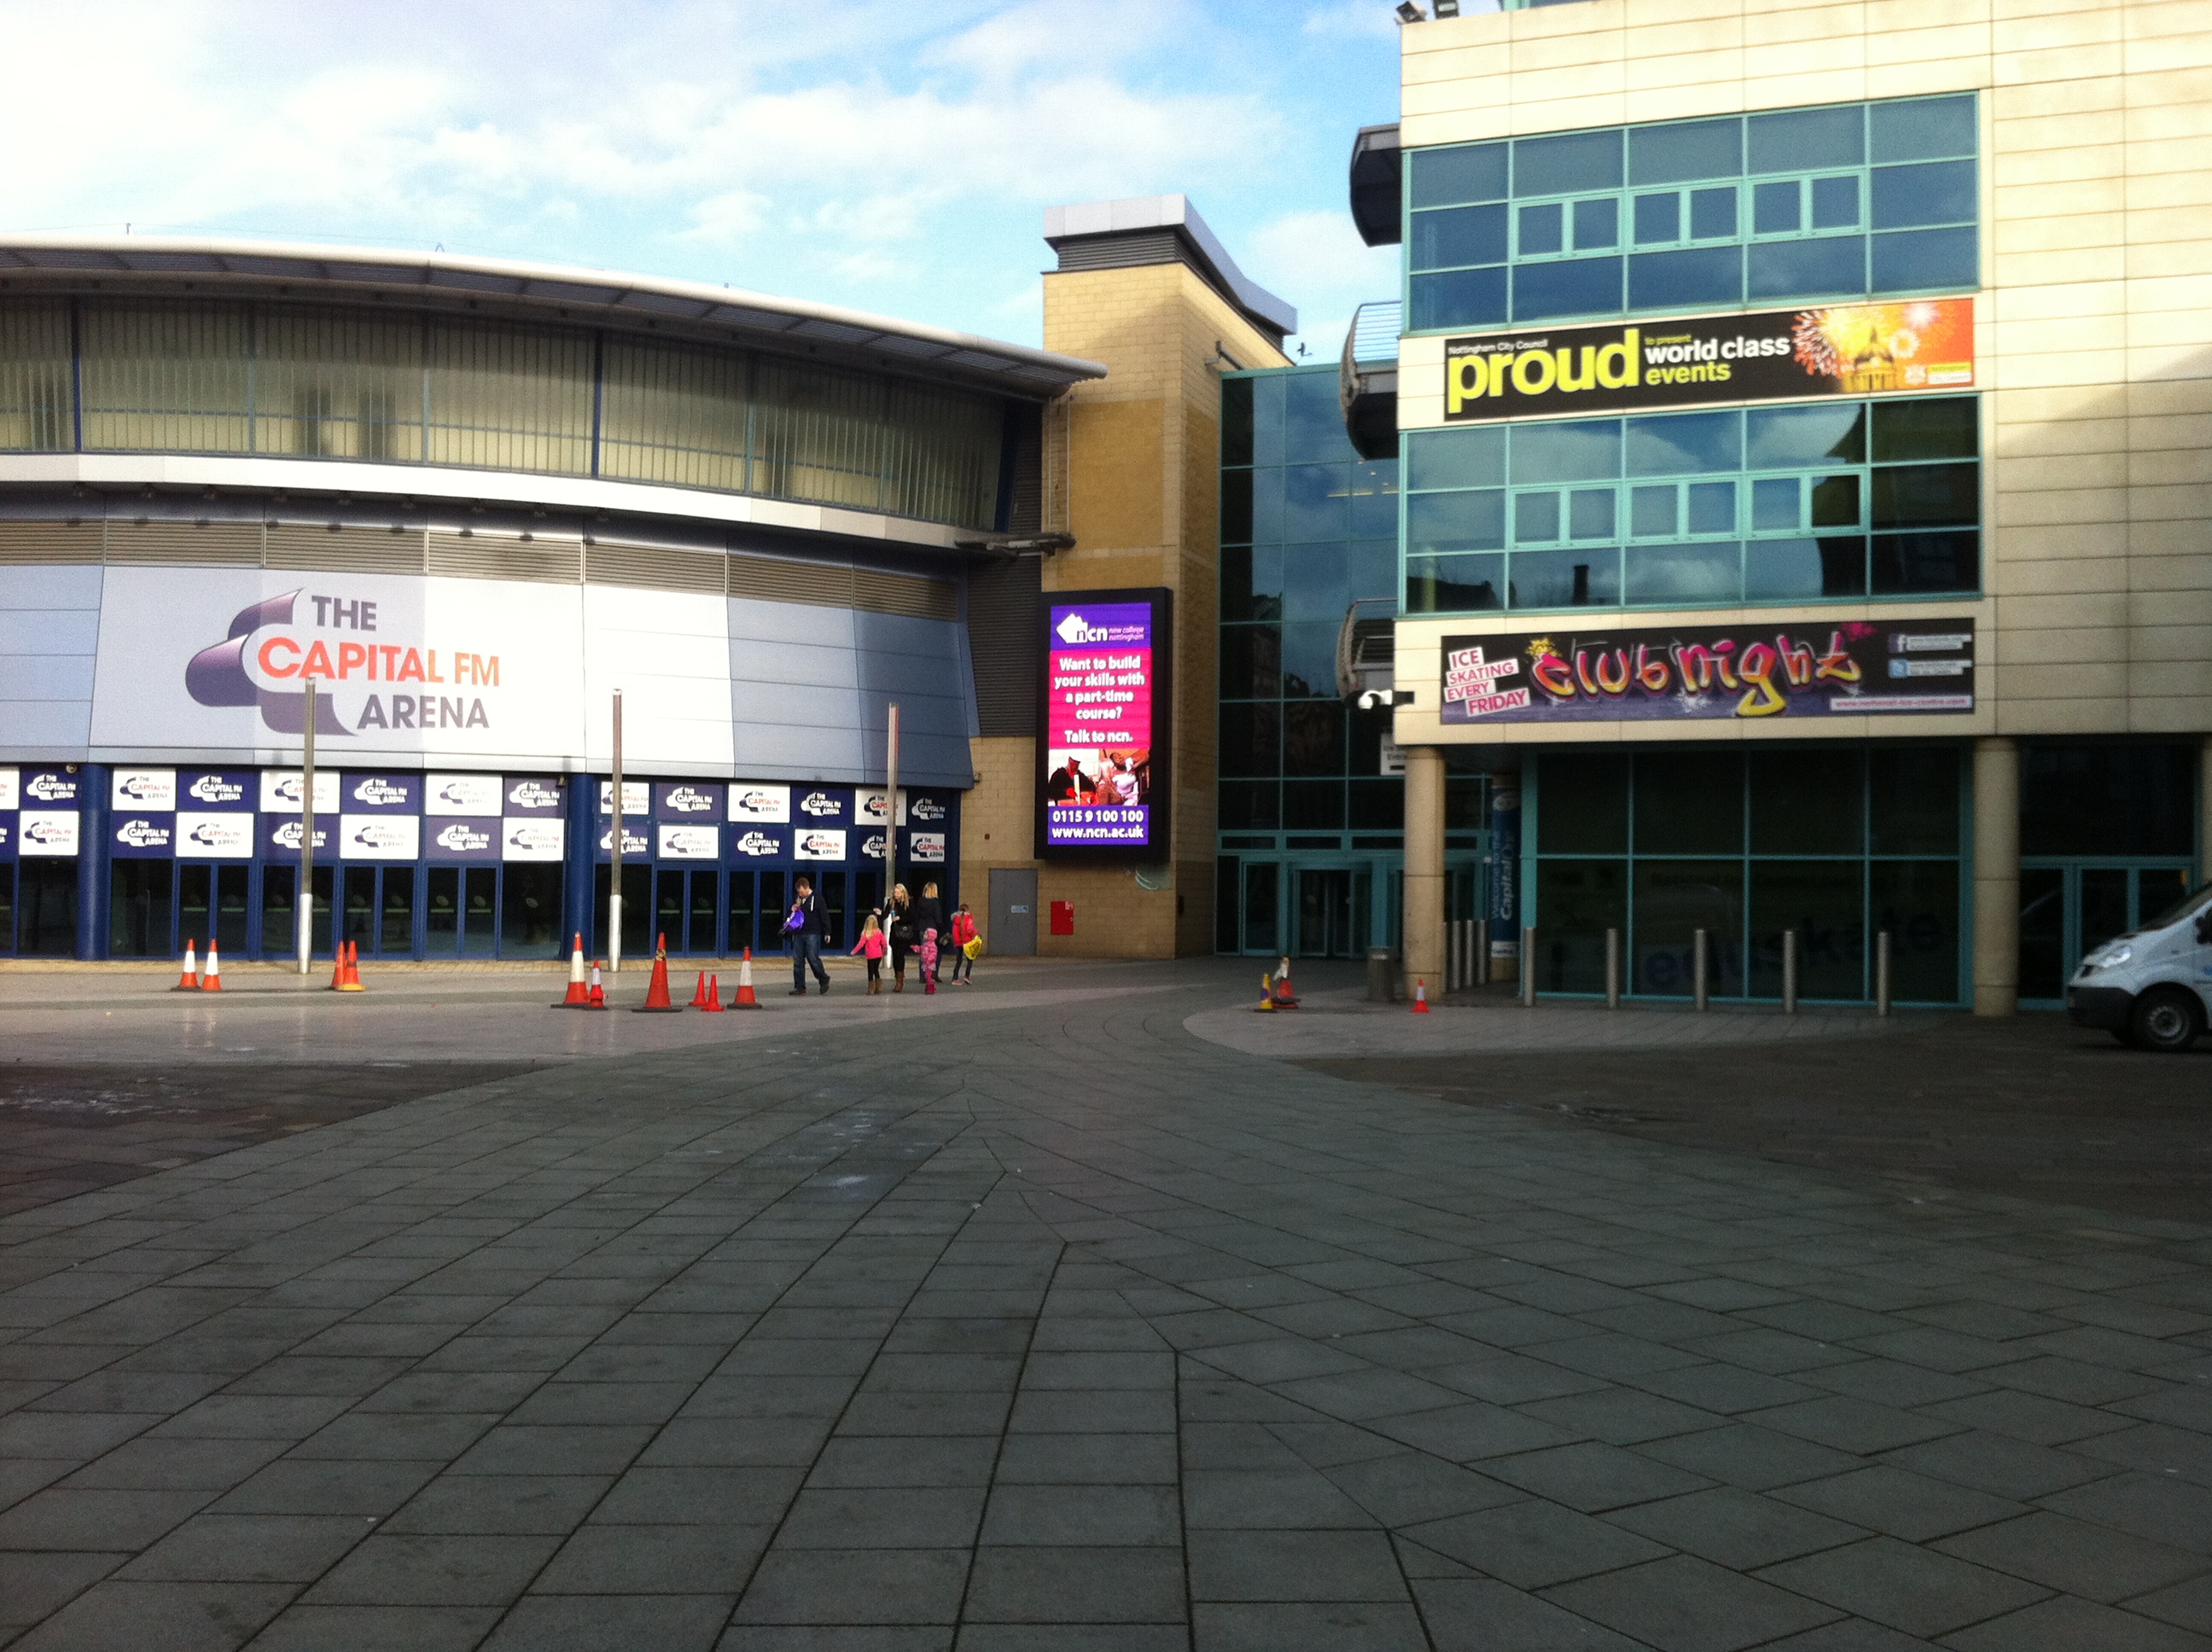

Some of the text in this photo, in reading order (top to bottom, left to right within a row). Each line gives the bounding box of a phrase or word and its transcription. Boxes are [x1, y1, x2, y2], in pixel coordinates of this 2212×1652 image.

[1448, 339, 1548, 355] Nottingham City Council
[1656, 334, 1691, 346] present
[1644, 336, 1790, 364] world class
[1448, 329, 1639, 414] proud
[1645, 362, 1731, 385] events
[311, 595, 376, 631] THE
[1077, 628, 1108, 642] ncn
[258, 637, 500, 687] CAPITAL FM
[1059, 655, 1140, 671] Want to build
[1452, 650, 1480, 667] ICE
[1450, 662, 1514, 684] SKATING
[1055, 672, 1144, 689] your skills with
[1066, 690, 1133, 706] a part-time
[1447, 683, 1489, 700] EVERY
[1469, 690, 1526, 714] FRIDAY
[357, 694, 490, 730] ARENA
[1076, 706, 1122, 719] course?
[1064, 730, 1133, 743] Talk to ncn.
[38, 782, 67, 791] CAPITAL
[201, 782, 233, 793] CAPITAL
[365, 786, 398, 796] CAPITAL
[520, 789, 550, 799] CAPITAL
[676, 794, 703, 803] CAPITAL
[811, 800, 834, 808] CAPITAL
[1053, 811, 1144, 823] 0115 9 100 100
[129, 828, 160, 837] CAPITAL
[448, 832, 480, 841] CAPITAL
[1052, 824, 1144, 838] www.ncn.ac.uk
[747, 838, 771, 847] CAPITAL
